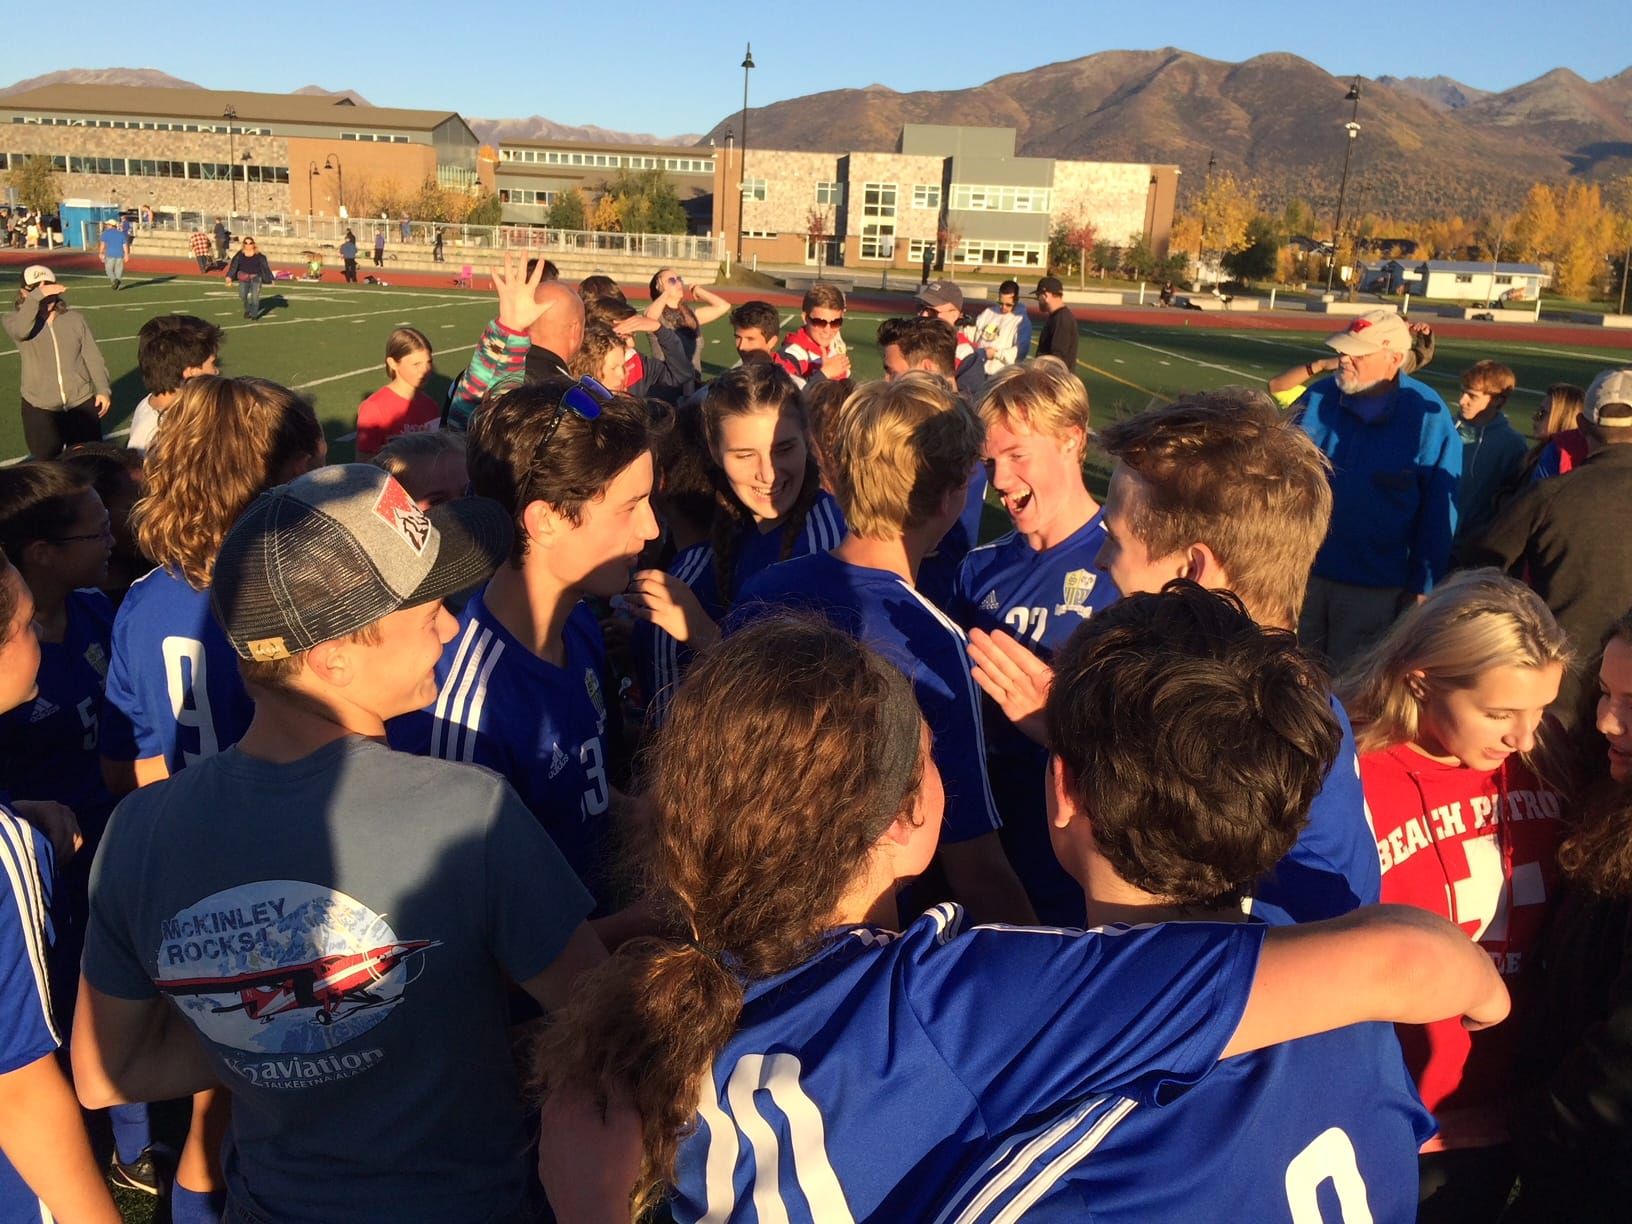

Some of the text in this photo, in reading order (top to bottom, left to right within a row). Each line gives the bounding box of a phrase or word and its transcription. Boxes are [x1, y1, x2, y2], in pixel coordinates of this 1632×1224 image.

[161, 636, 219, 768] 9
[580, 737, 609, 823] 3
[1377, 789, 1561, 876] BEACH PATRO
